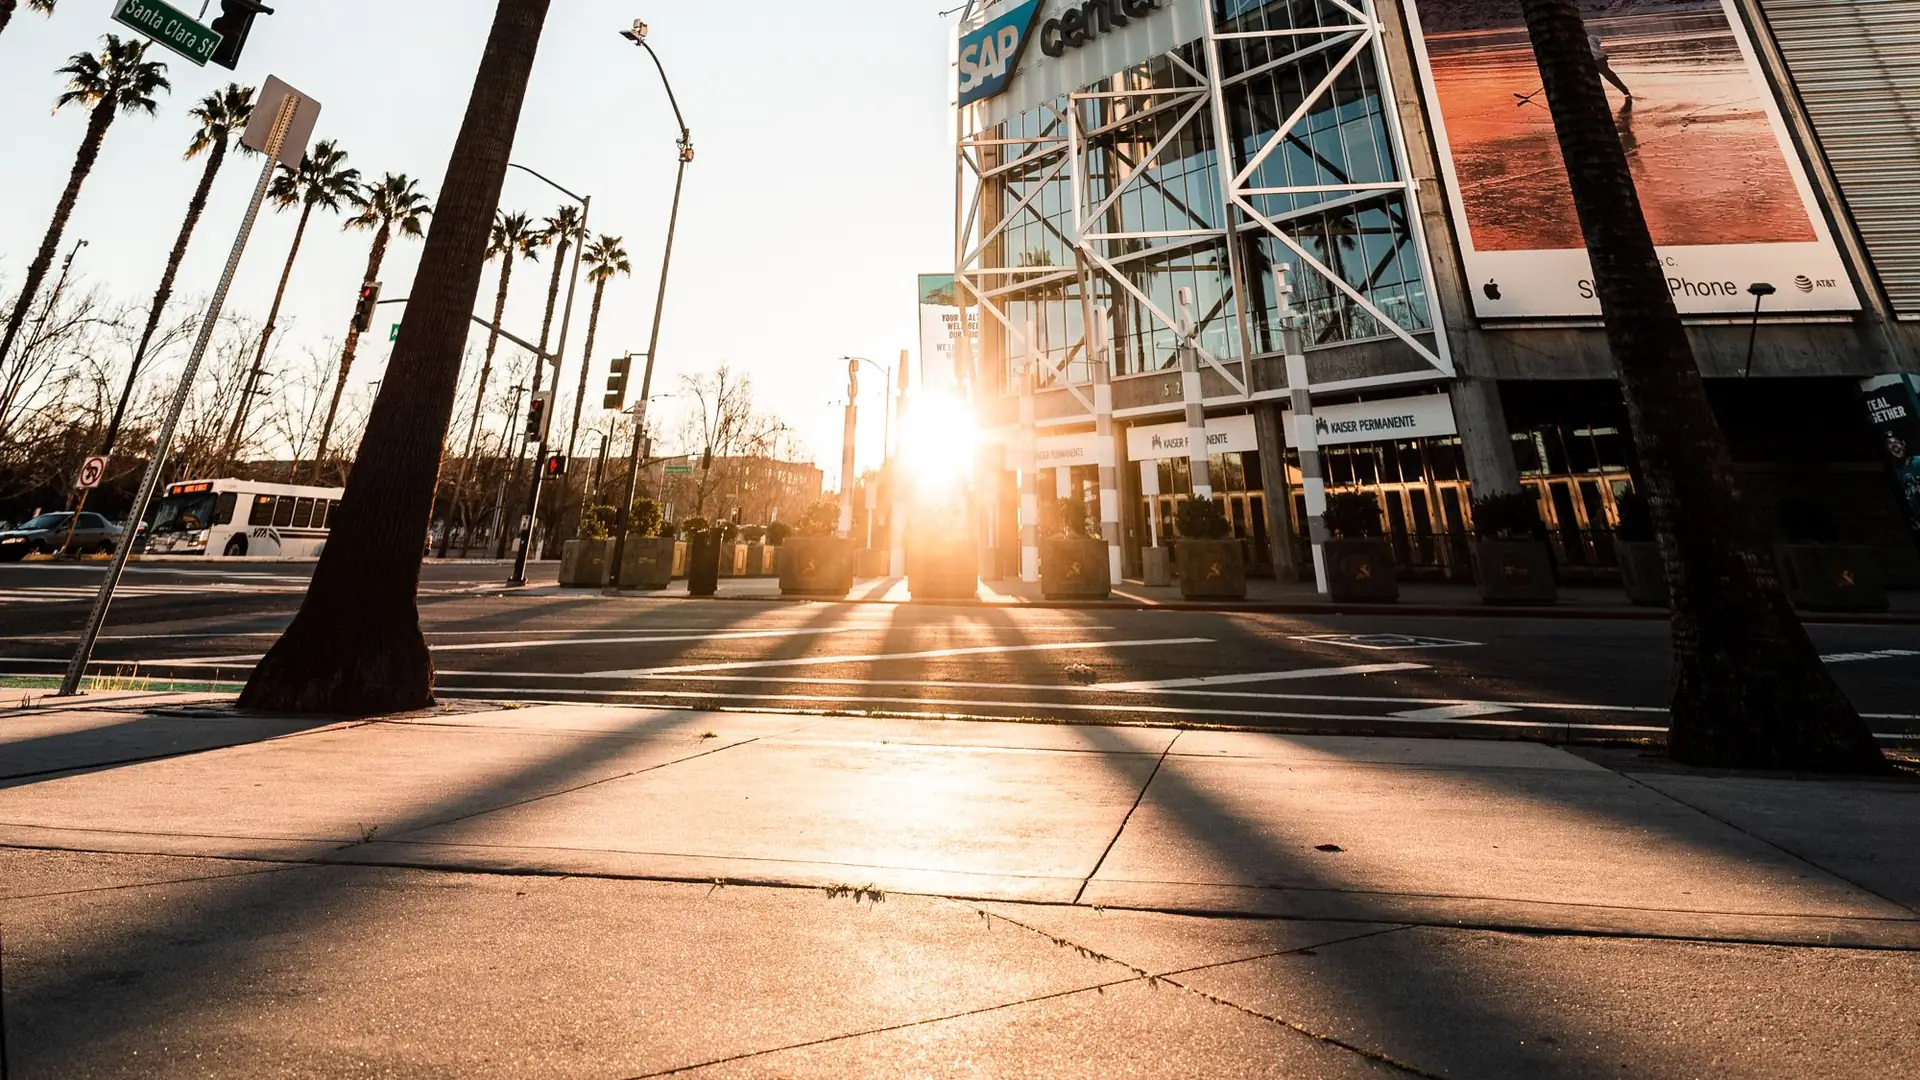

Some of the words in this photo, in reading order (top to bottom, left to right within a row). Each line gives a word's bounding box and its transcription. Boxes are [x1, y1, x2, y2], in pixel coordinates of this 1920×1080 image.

[126, 0, 163, 29] Santa
[165, 20, 197, 48] Clara
[197, 38, 215, 56] St
[960, 25, 1018, 93] SAP
[1041, 0, 1162, 57] cente
[1667, 277, 1738, 297] Phone
[1816, 279, 1837, 288] AT&T
[942, 314, 959, 322] YOUR
[1330, 420, 1357, 434] KAISER
[1359, 414, 1416, 431] PERMANENTE
[1163, 437, 1184, 449] KAISER
[253, 527, 267, 538] VTA
